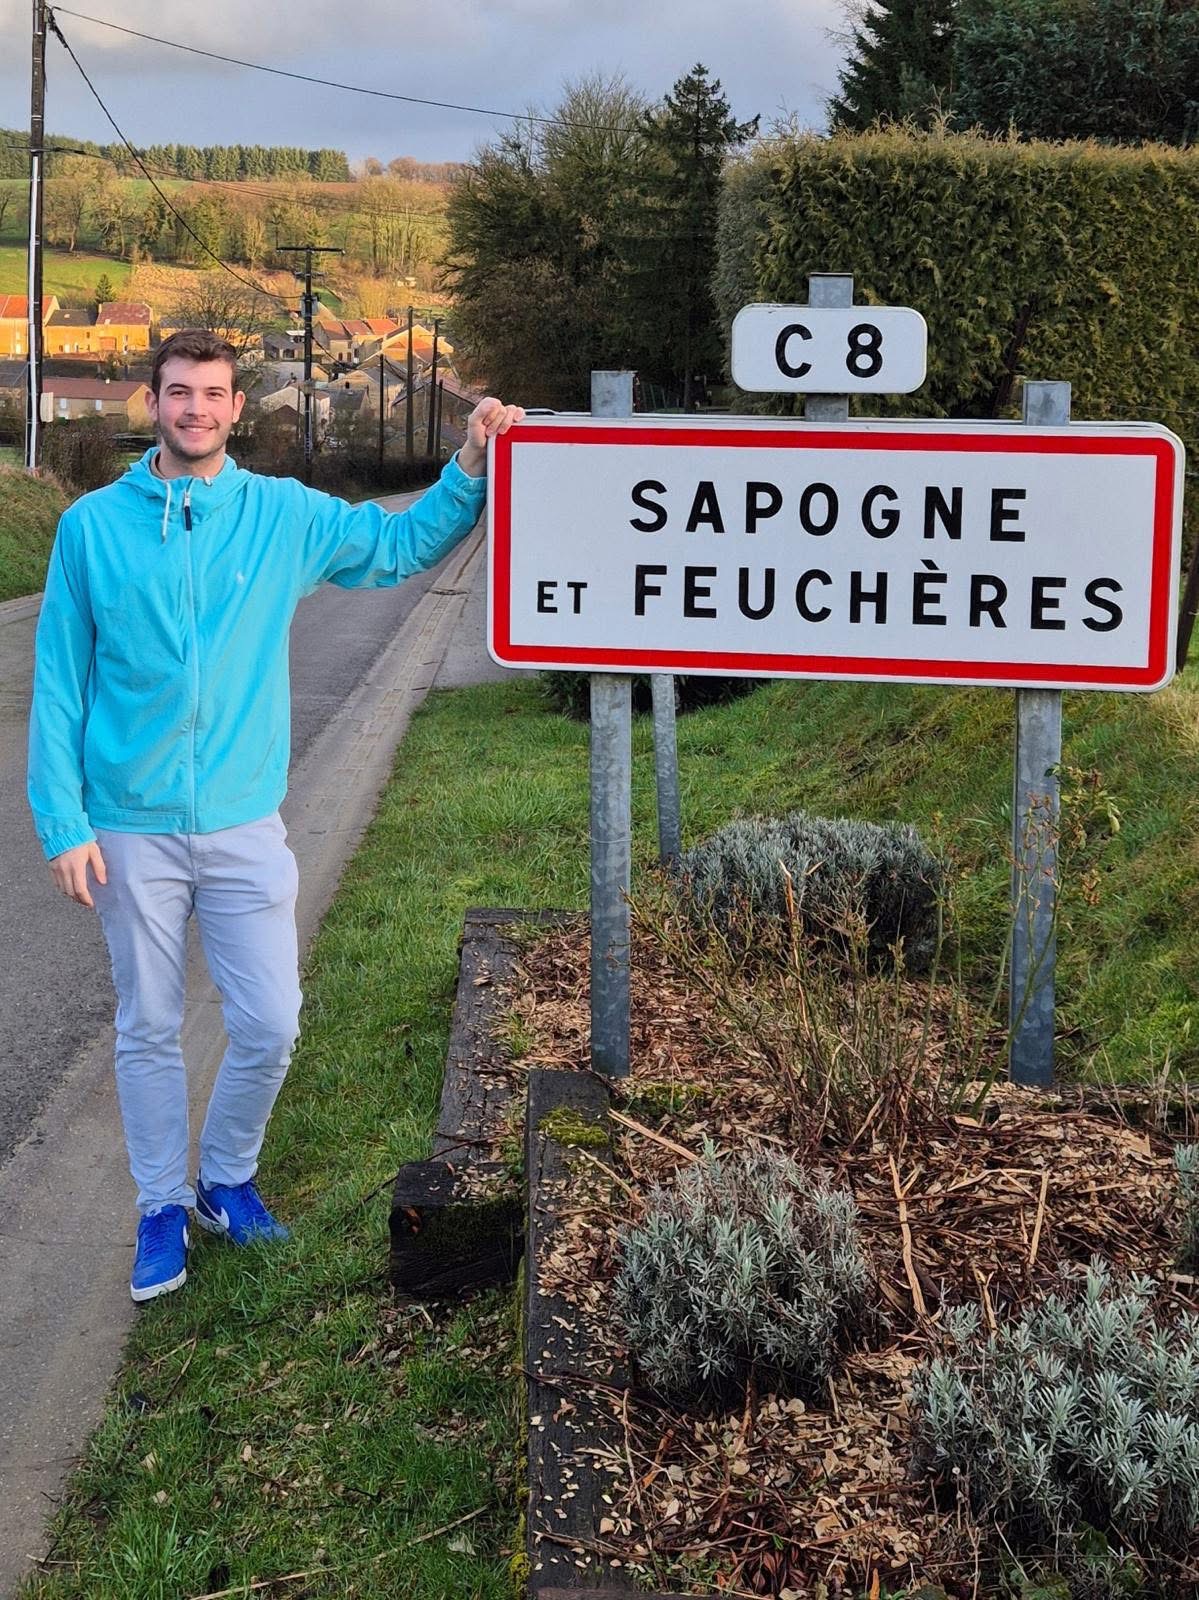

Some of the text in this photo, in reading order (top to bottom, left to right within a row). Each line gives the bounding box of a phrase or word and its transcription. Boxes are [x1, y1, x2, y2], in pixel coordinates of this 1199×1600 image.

[774, 323, 883, 379] C 8
[629, 479, 1027, 543] SAPOGNE
[536, 559, 1124, 633] ET FEUCHÈRES
